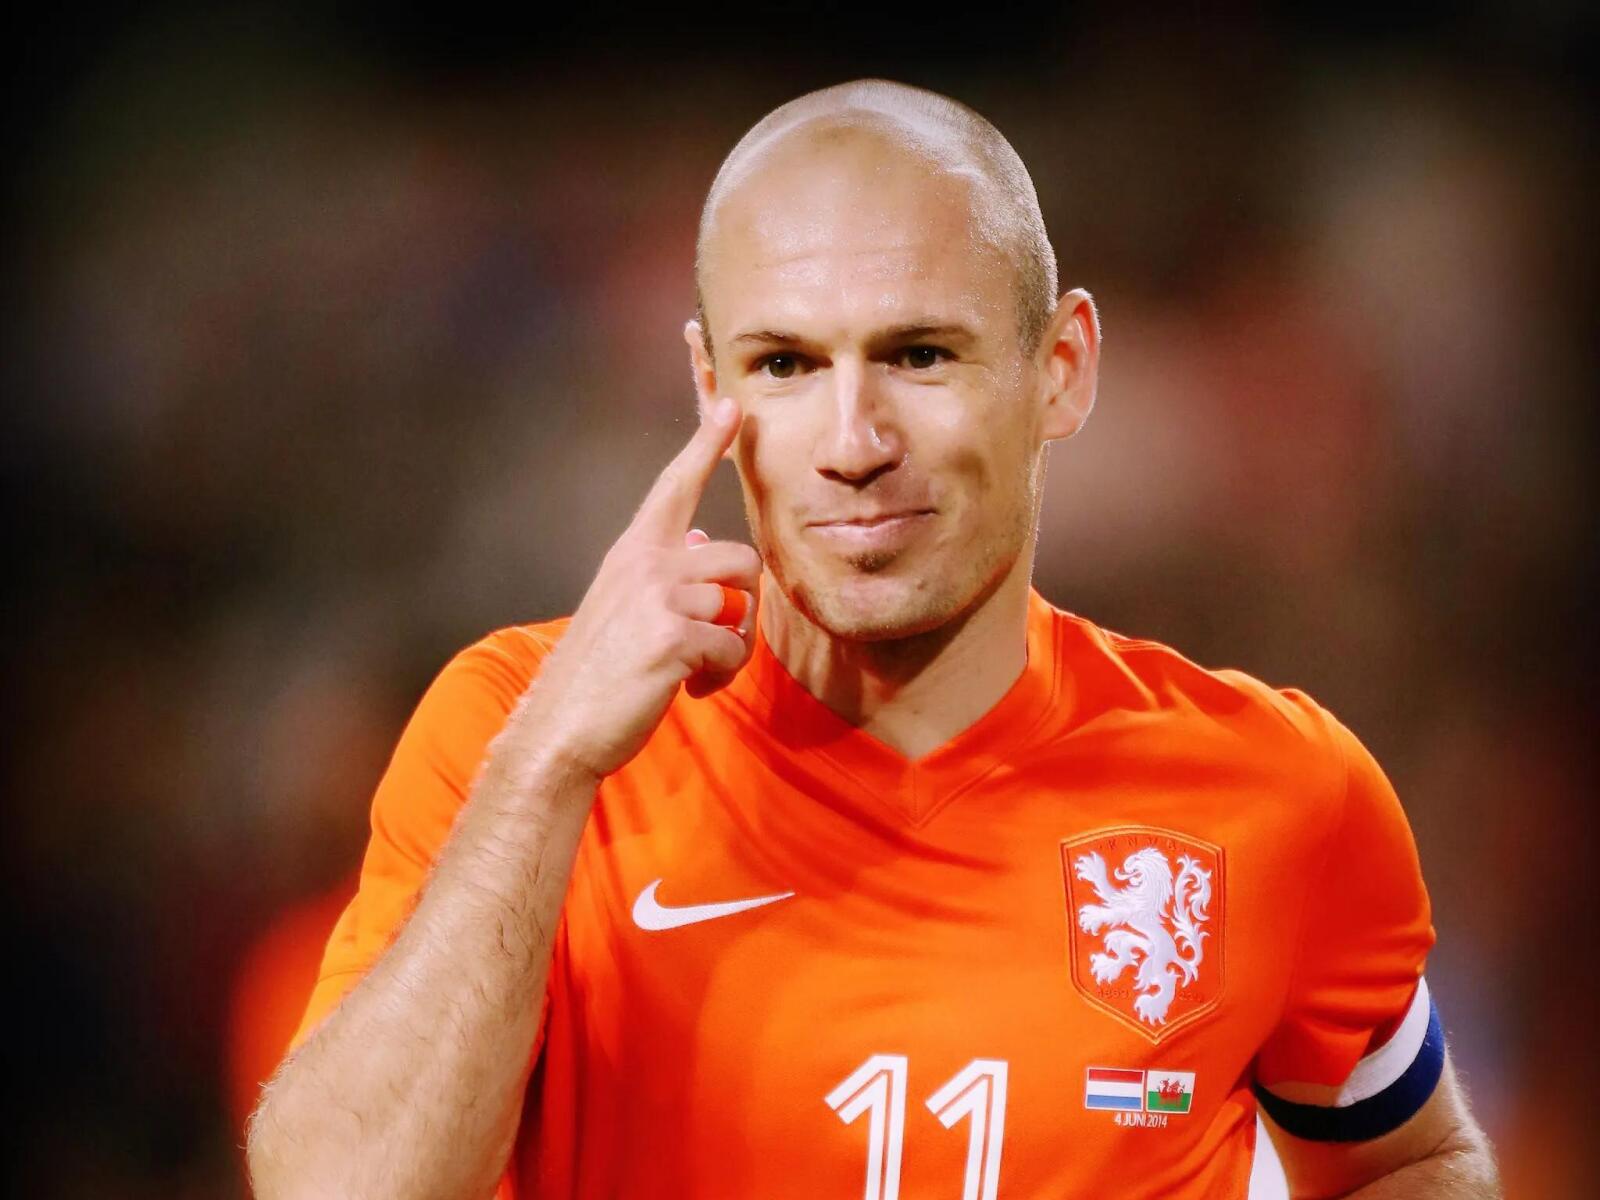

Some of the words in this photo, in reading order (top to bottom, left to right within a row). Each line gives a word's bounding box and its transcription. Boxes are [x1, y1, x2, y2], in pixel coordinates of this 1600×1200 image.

[1113, 1112, 1122, 1126] 4
[1122, 1112, 1147, 1127] JUNI
[1147, 1113, 1169, 1128] 2014
